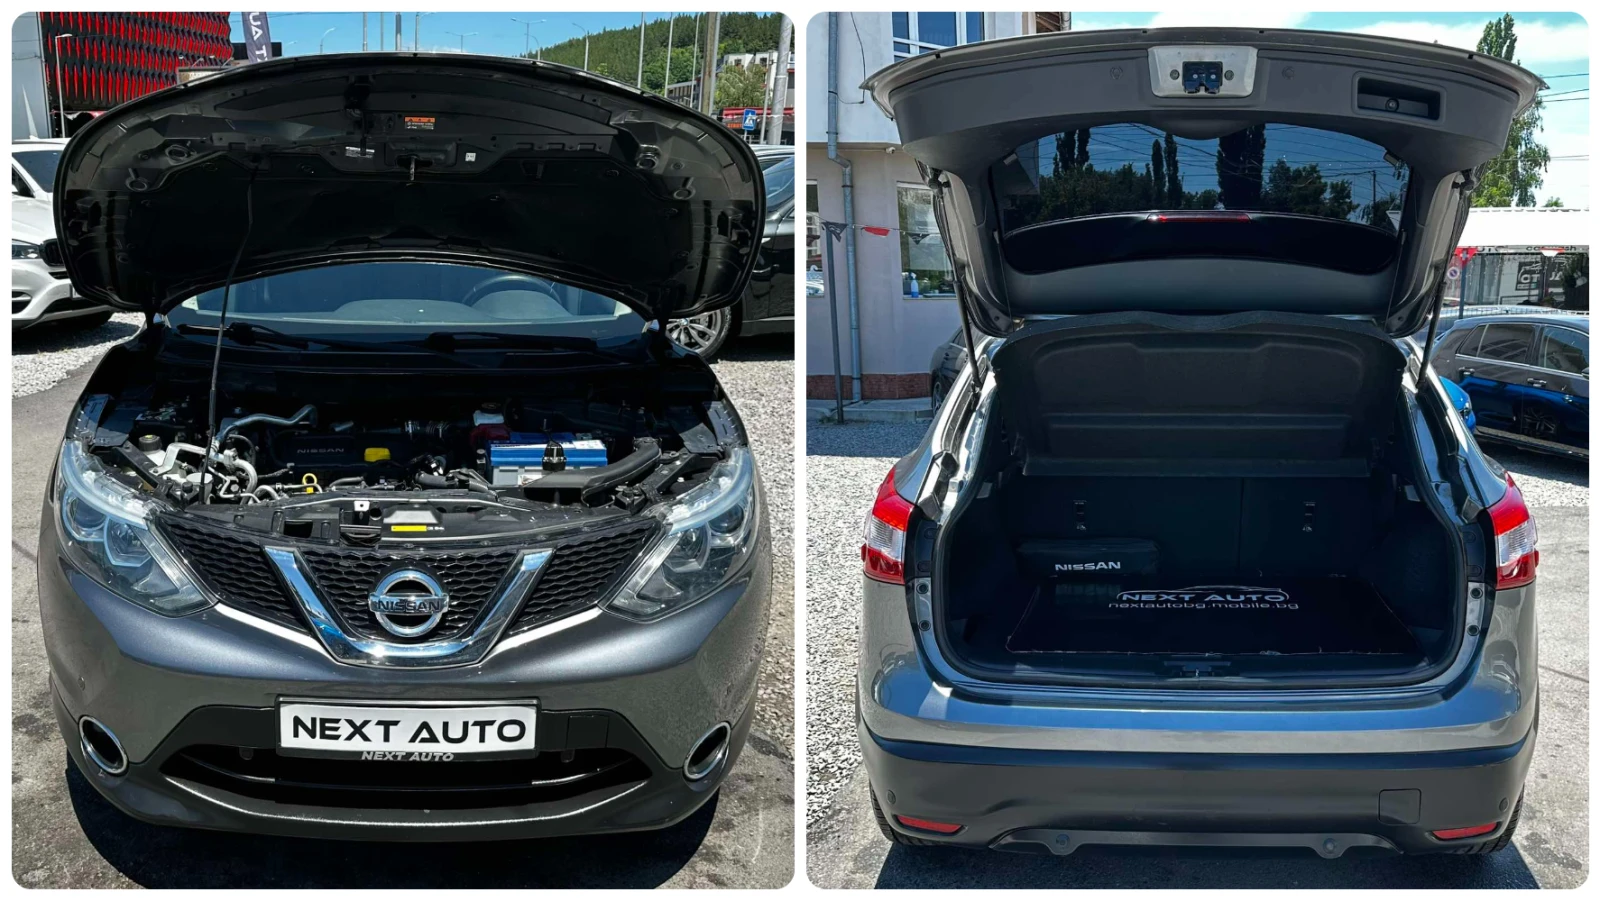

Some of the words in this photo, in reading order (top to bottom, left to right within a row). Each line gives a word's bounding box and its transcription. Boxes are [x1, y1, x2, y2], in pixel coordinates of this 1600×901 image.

[1055, 561, 1122, 571] NISSAN
[1204, 594, 1286, 602] AUTO
[377, 599, 440, 613] NISSAN
[1108, 602, 1299, 610] nextautobg.mobile.bg
[292, 715, 401, 743] NEXT
[408, 718, 527, 744] AUTO
[361, 751, 406, 761] NEXT
[409, 751, 454, 762] AUTO
